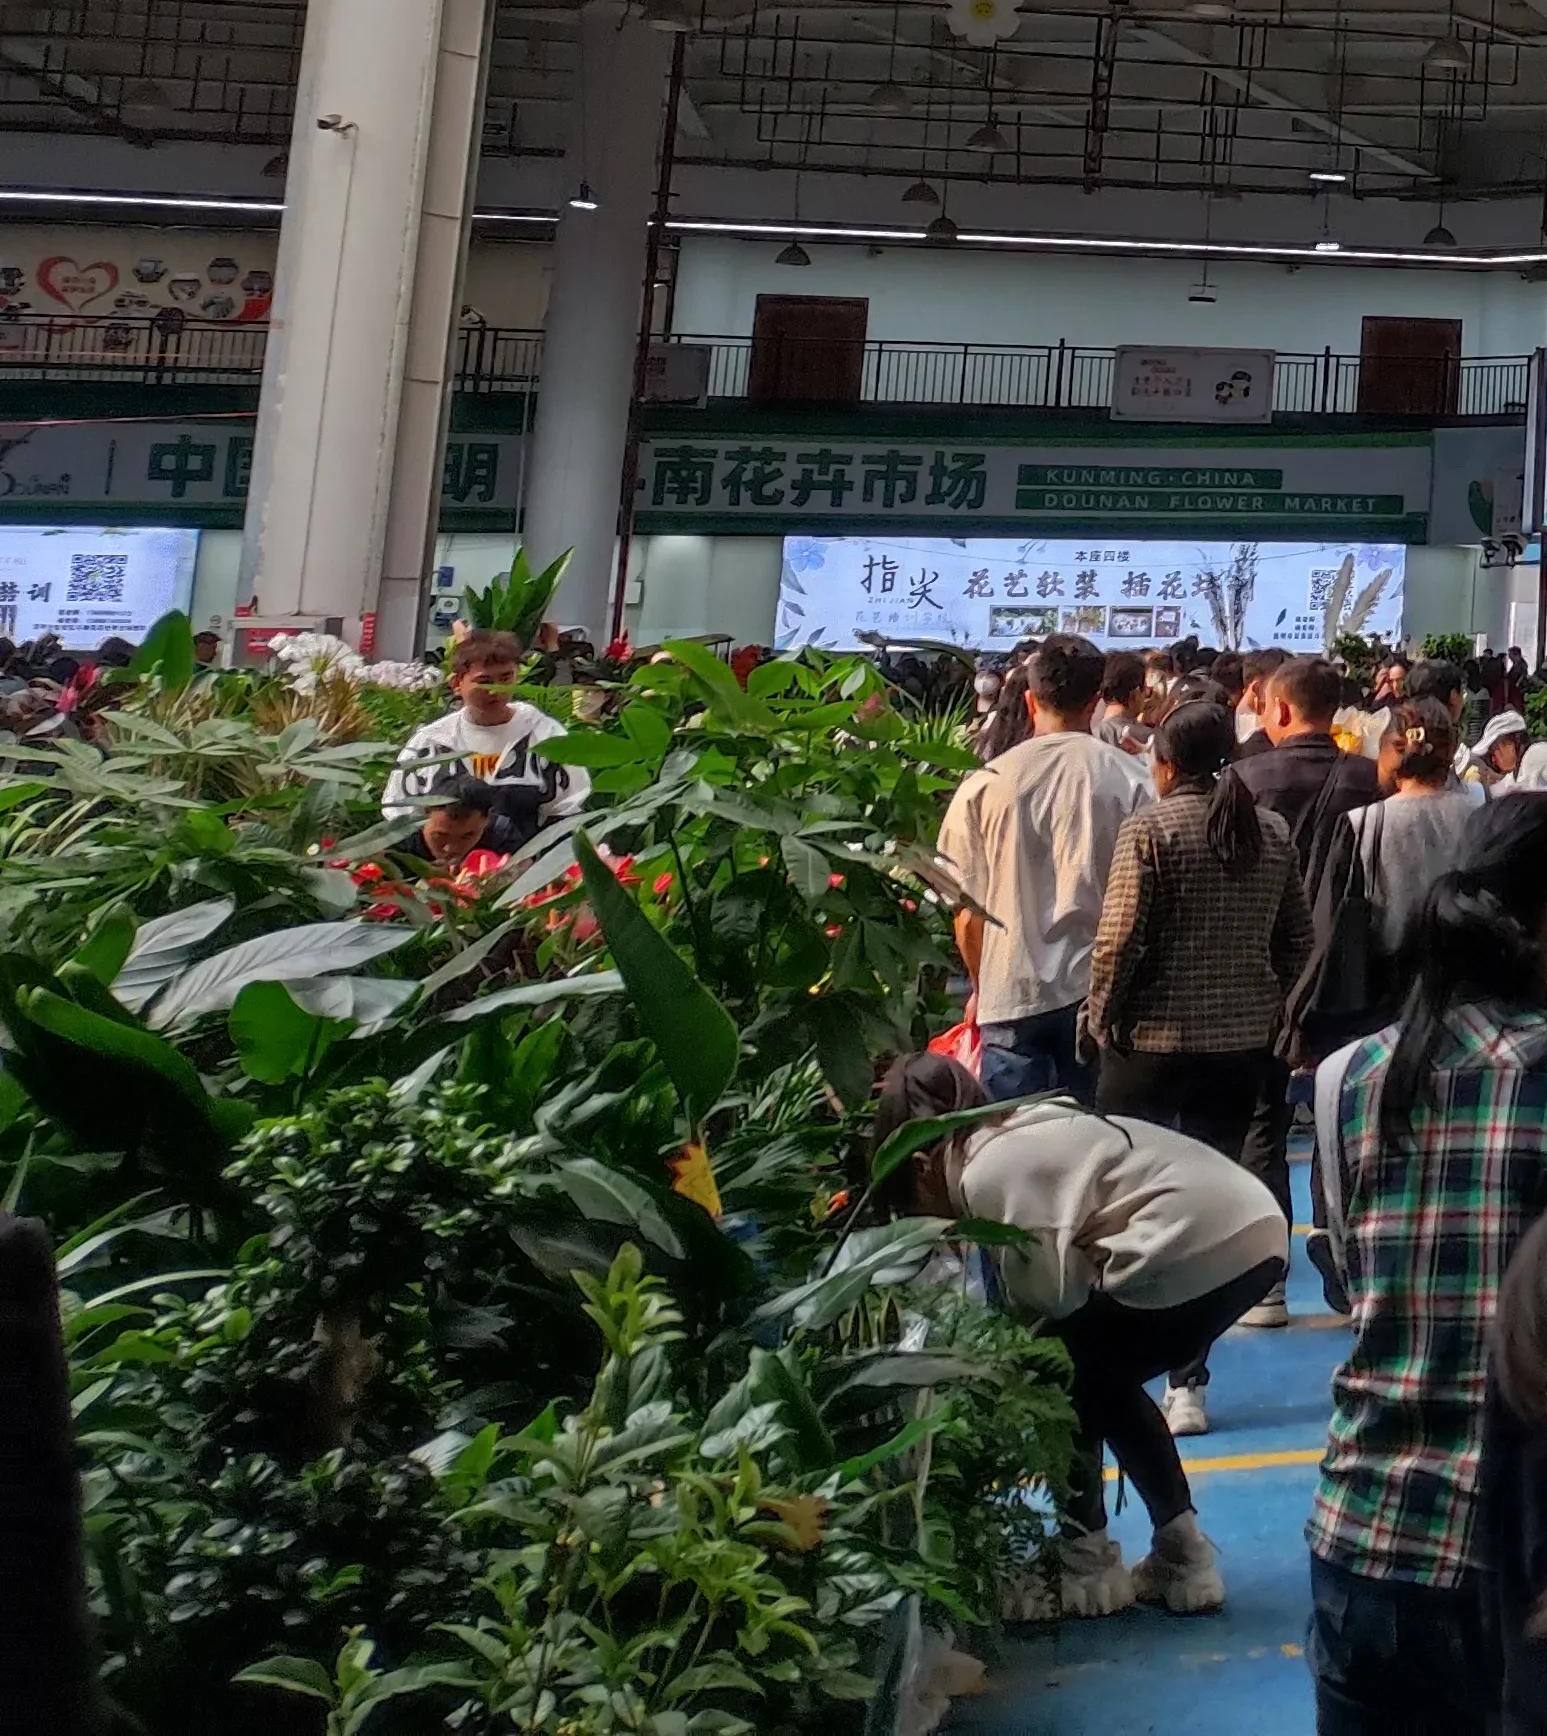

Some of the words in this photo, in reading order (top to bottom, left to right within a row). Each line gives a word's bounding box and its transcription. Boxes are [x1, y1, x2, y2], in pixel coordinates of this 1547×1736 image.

[1043, 492, 1149, 510] DOUNAN
[1168, 495, 1265, 511] FLOWER
[1284, 497, 1377, 513] MARKET
[860, 554, 944, 610] 指尖
[962, 567, 1100, 600] 花艺软装
